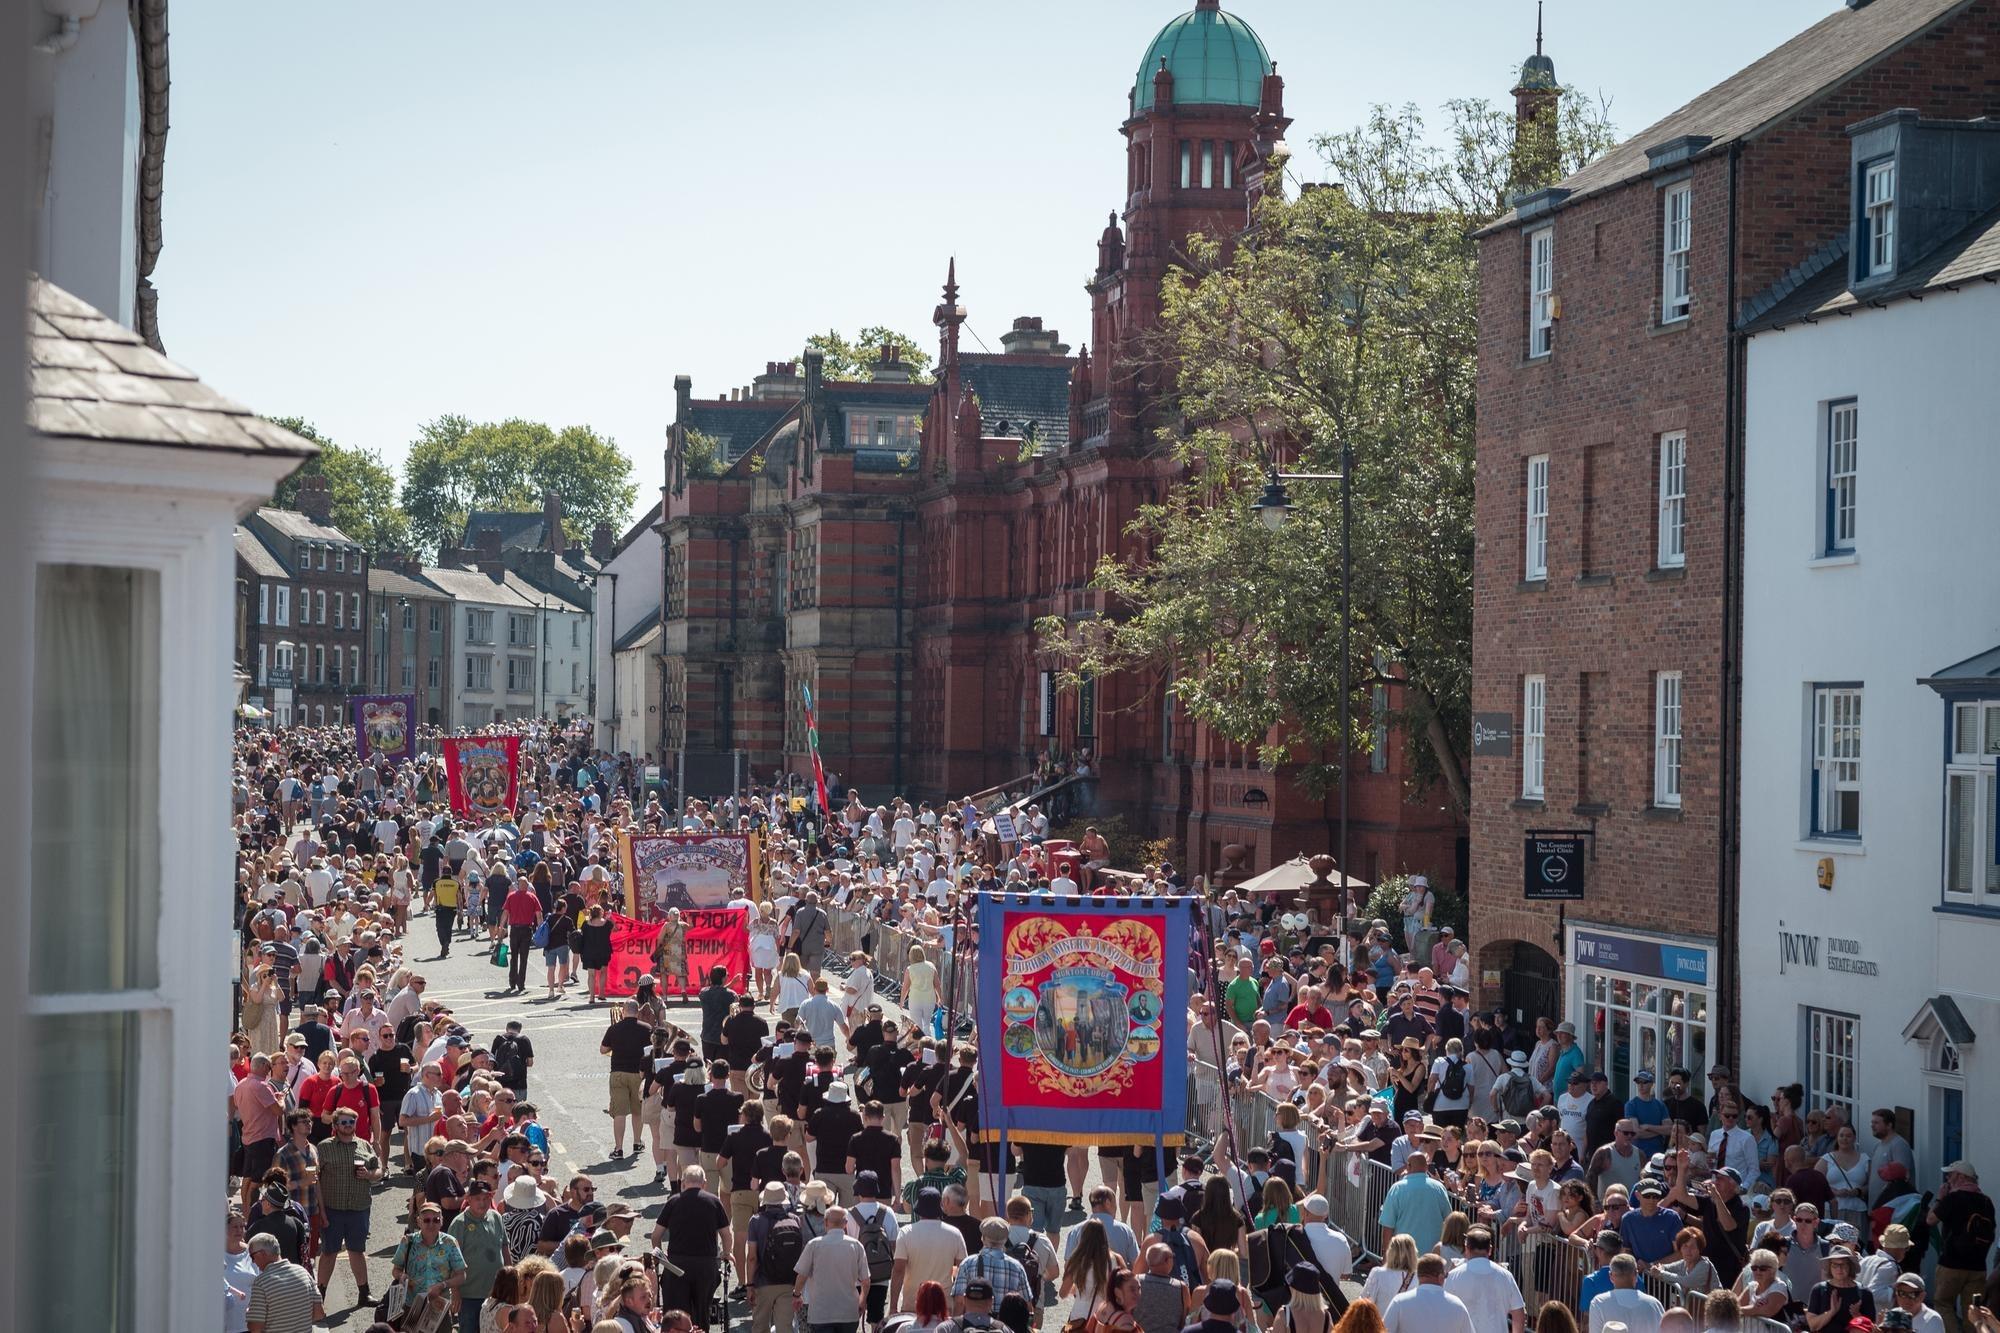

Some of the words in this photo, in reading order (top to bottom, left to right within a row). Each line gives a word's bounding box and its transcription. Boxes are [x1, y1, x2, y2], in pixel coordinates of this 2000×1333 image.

[1012, 953, 1051, 973] DURHAM
[1095, 940, 1157, 977] ASSOCIATION
[1827, 956, 1850, 973] ESTATE
[1851, 959, 1878, 977] AGENTS
